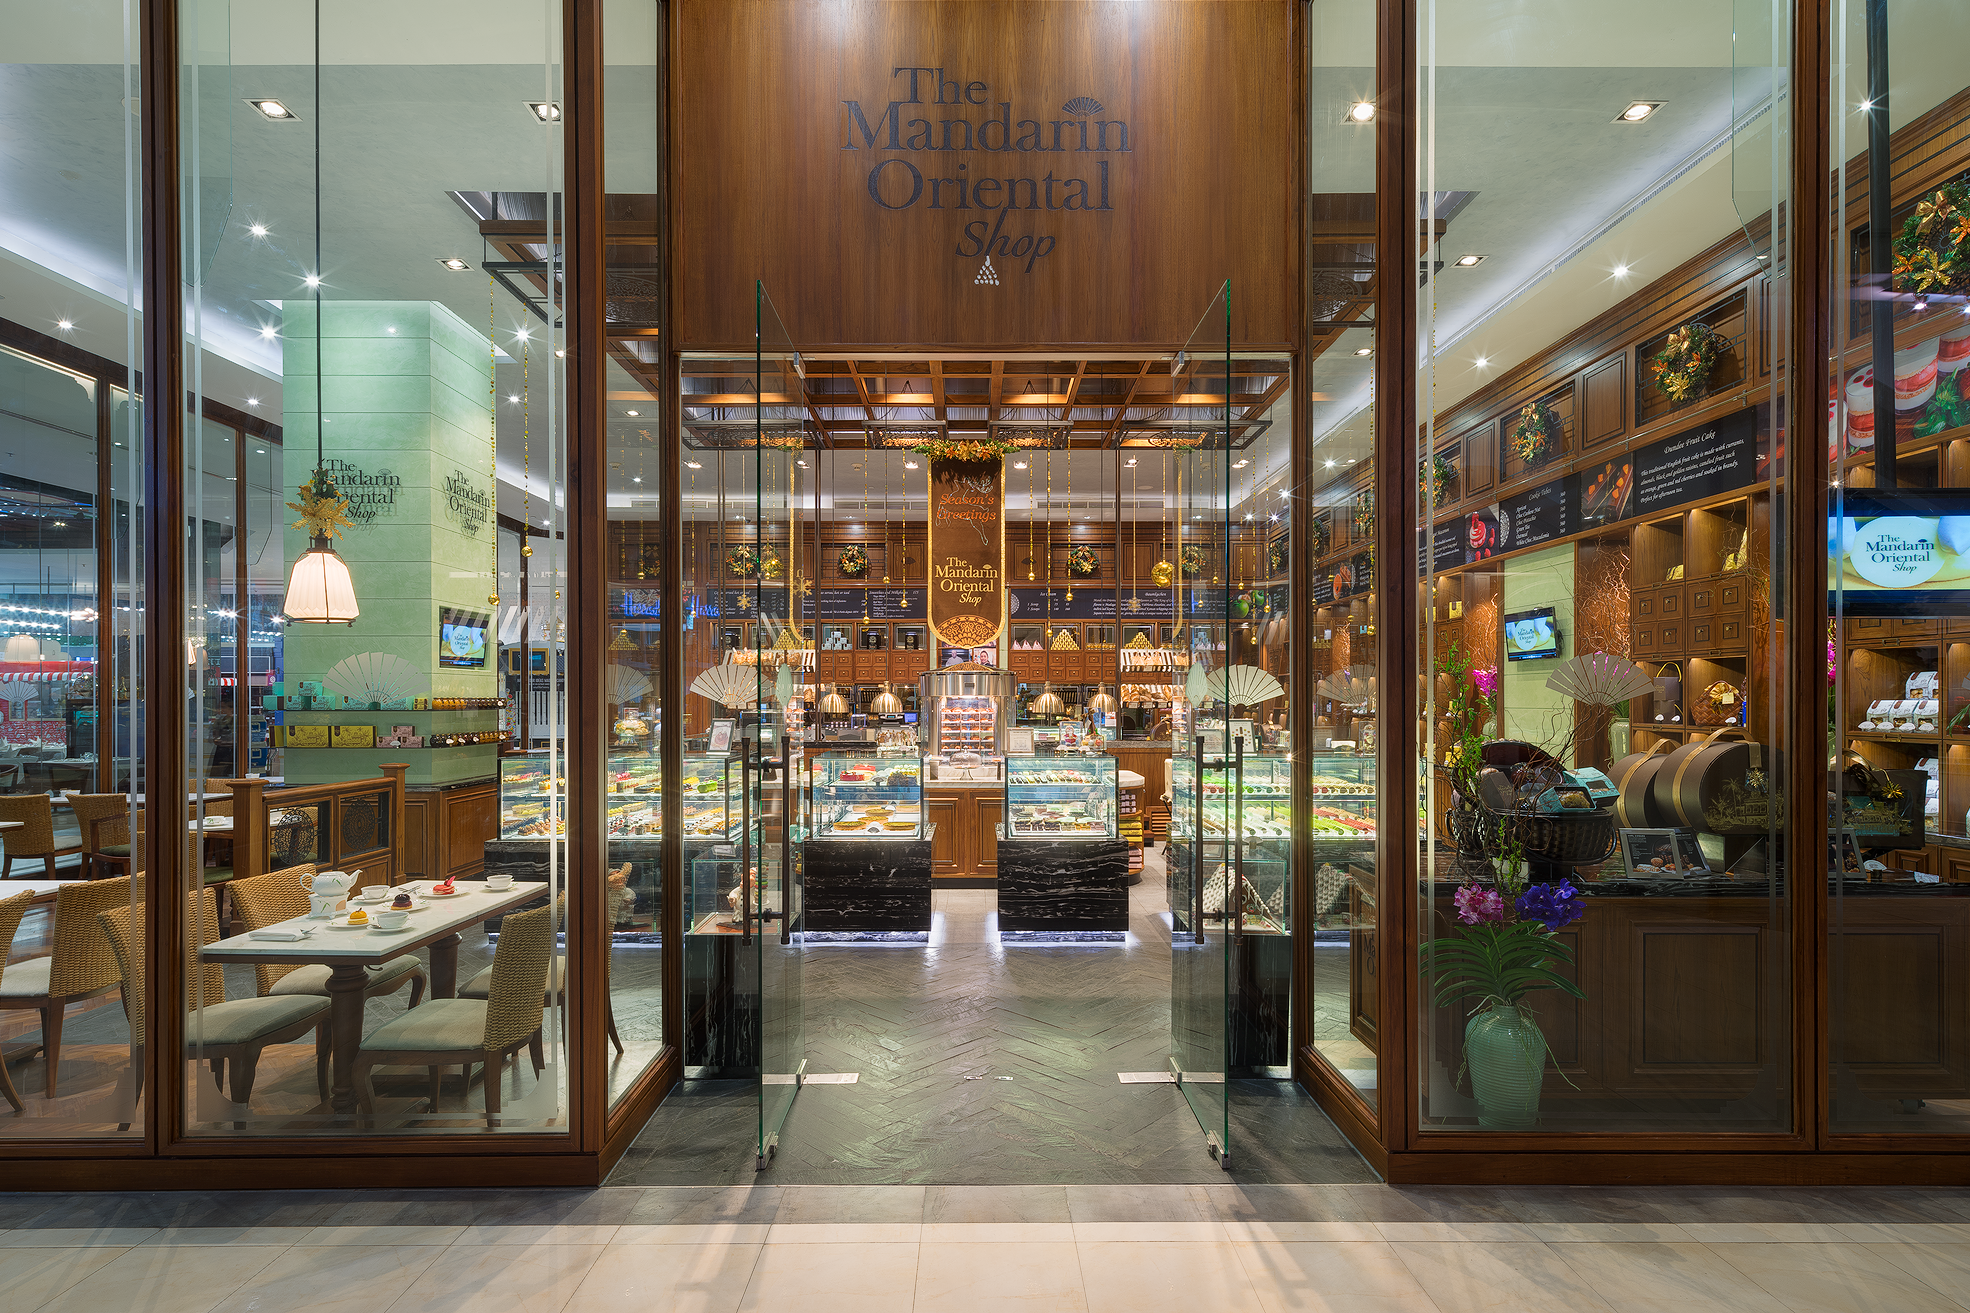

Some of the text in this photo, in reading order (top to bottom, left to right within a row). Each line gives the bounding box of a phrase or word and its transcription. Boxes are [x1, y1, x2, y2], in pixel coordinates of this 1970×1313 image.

[894, 67, 988, 105] The
[840, 101, 1132, 152] Mandarin
[867, 159, 1114, 211] Oriental
[955, 206, 1056, 274] Shop
[1664, 430, 1715, 453] Dundee Fruit Cake
[326, 459, 355, 471] The
[310, 470, 400, 486] andarin
[455, 469, 470, 486] The
[336, 488, 394, 504] riental
[446, 476, 491, 508] Mandarin
[940, 493, 995, 505] Season's
[345, 502, 376, 523] Shop
[450, 495, 487, 523] Oriental
[937, 508, 997, 523] Greetings
[464, 516, 479, 536] Shop
[1878, 534, 1900, 542] The
[1866, 541, 1935, 552] Mandarin
[947, 556, 968, 567] The
[1871, 551, 1930, 563] Oriental
[935, 565, 998, 578] Mandarin
[1892, 561, 1917, 574] Shop
[940, 579, 994, 592] Oriental
[959, 590, 982, 607] Shop
